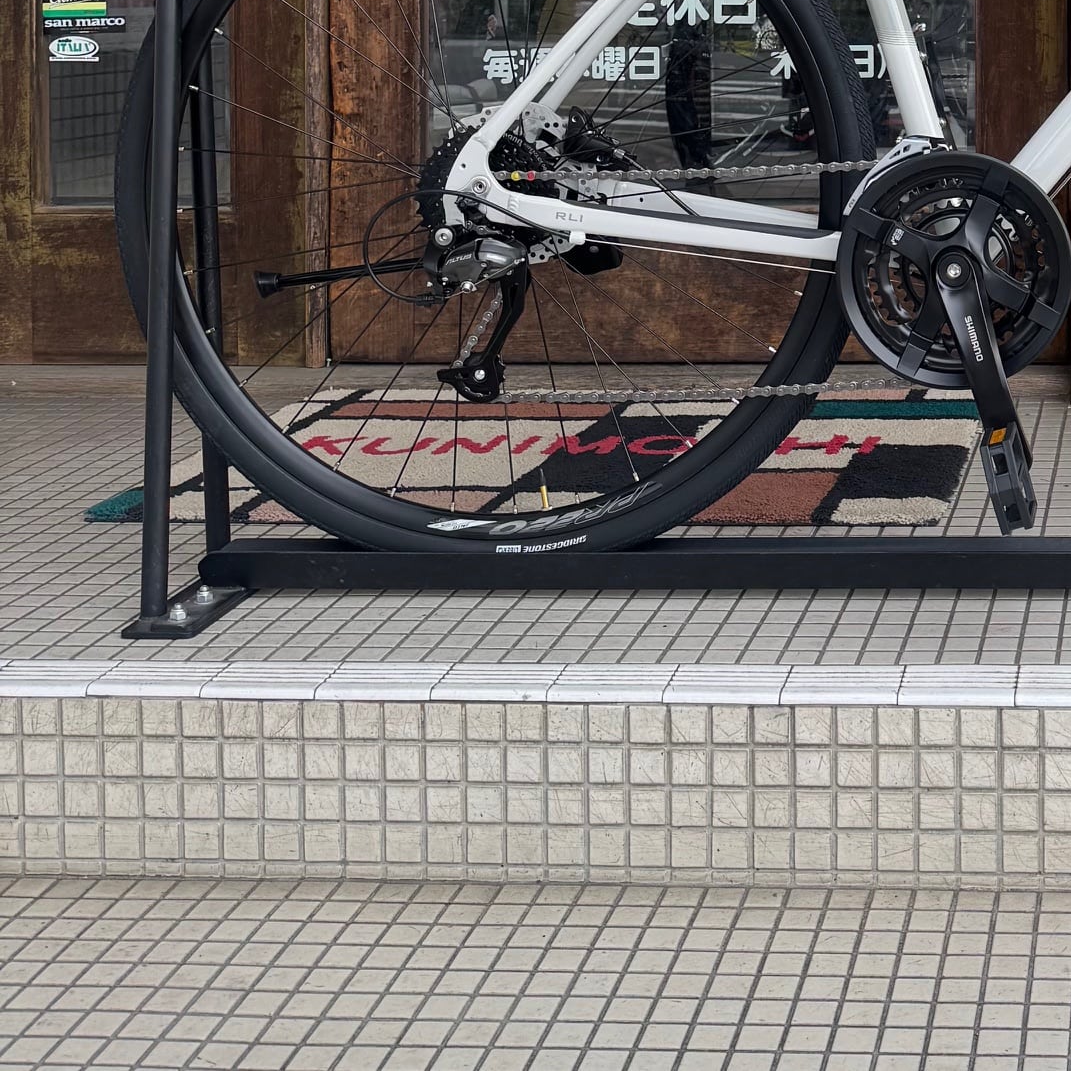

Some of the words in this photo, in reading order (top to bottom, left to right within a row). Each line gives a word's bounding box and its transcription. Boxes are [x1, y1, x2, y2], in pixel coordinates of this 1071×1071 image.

[44, 18, 73, 28] san
[75, 17, 126, 27] marco
[445, 253, 472, 266] ALTUS
[964, 315, 984, 362] SHIMANO
[300, 434, 882, 457] KUNIMOHI
[522, 534, 587, 553] BRIDGESTONE
